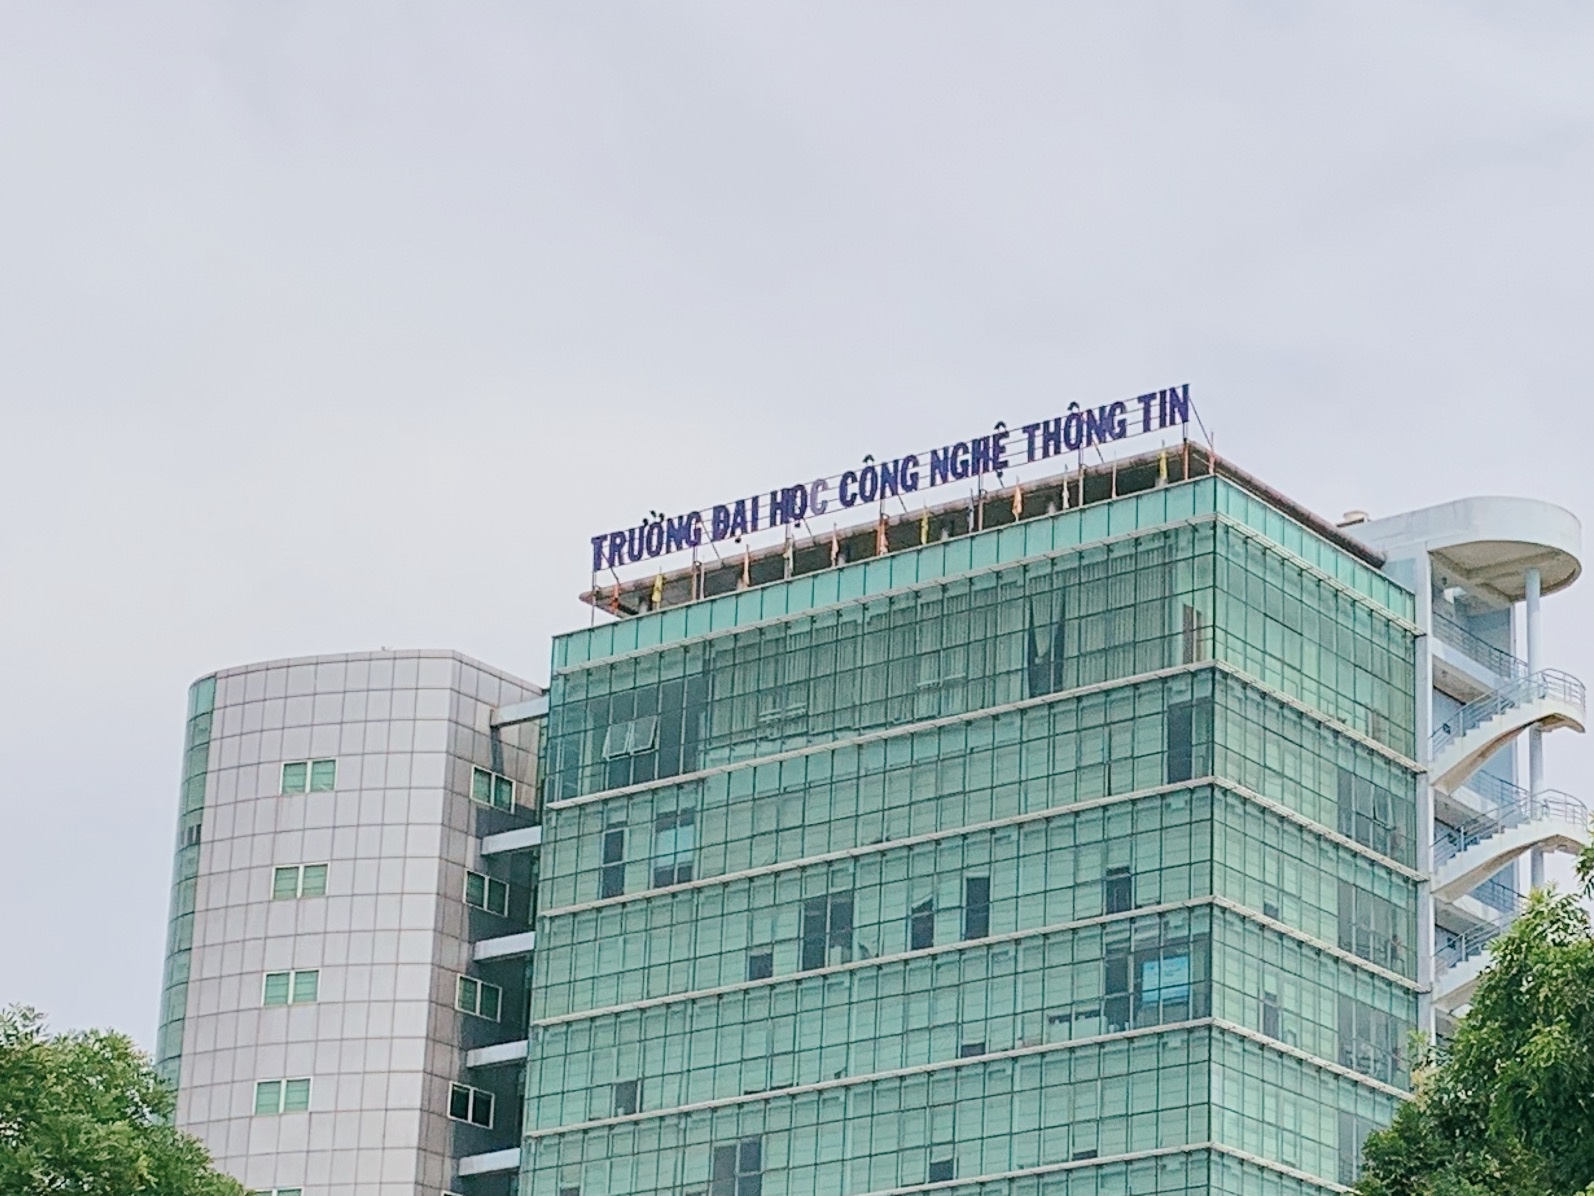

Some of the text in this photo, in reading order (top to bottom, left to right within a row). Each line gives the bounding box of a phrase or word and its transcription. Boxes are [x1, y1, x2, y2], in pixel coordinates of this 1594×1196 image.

[591, 384, 1190, 572] TRƯỜNG ĐẠI HỌC CÔNG NGHỆ THÔNG TIN
